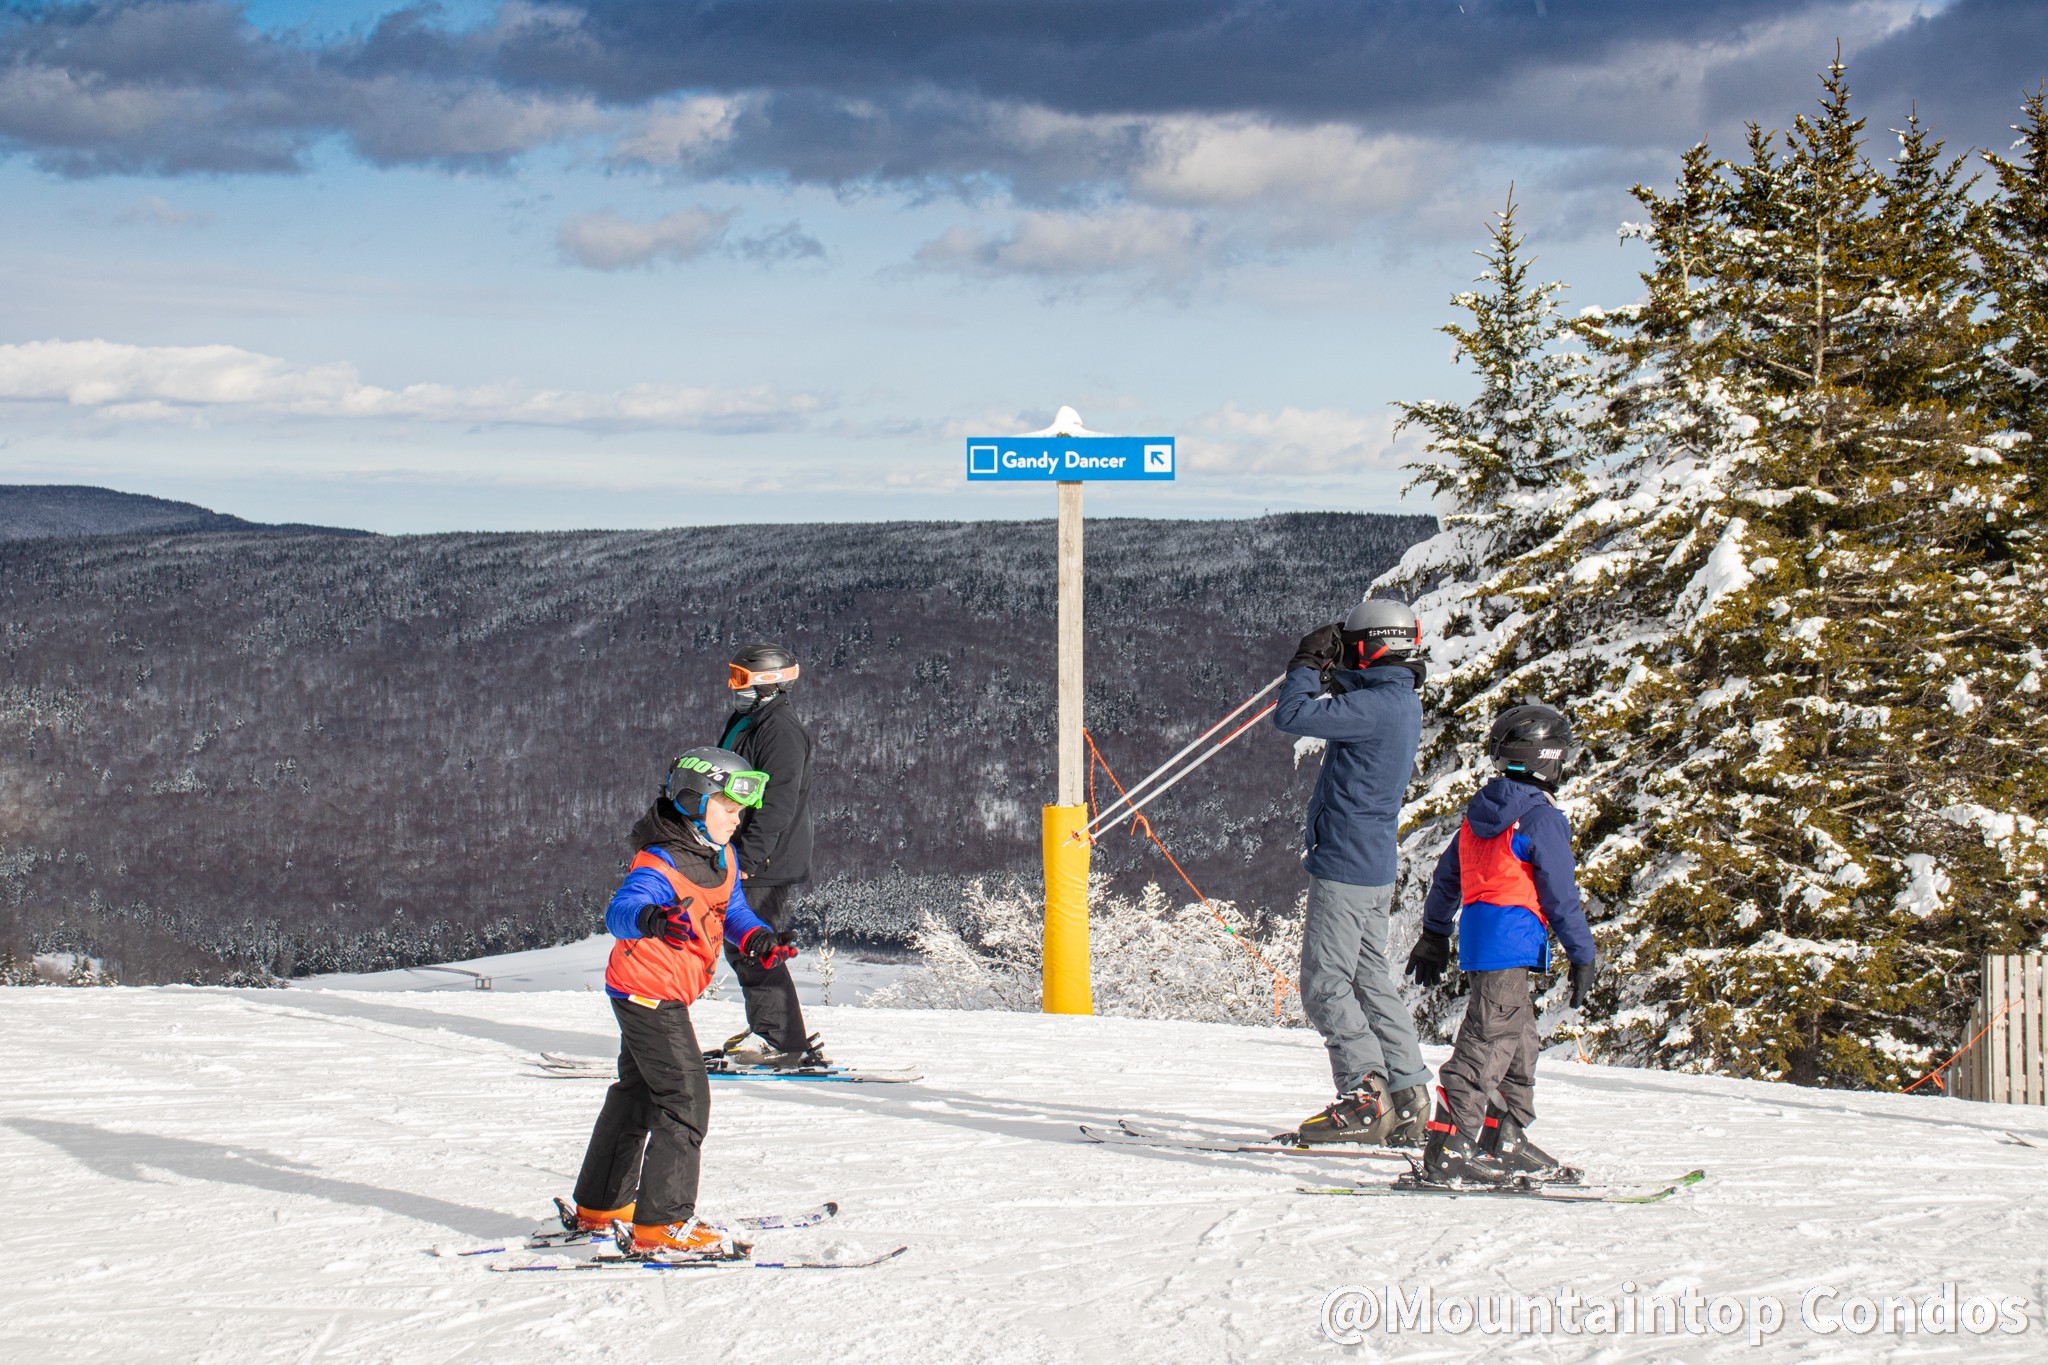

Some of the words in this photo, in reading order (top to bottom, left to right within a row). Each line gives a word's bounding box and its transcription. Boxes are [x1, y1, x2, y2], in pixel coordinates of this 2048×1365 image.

[1002, 451, 1059, 474] Gandy
[1065, 451, 1126, 468] Dancer
[1369, 628, 1407, 637] SMITH
[677, 757, 727, 781] 100%
